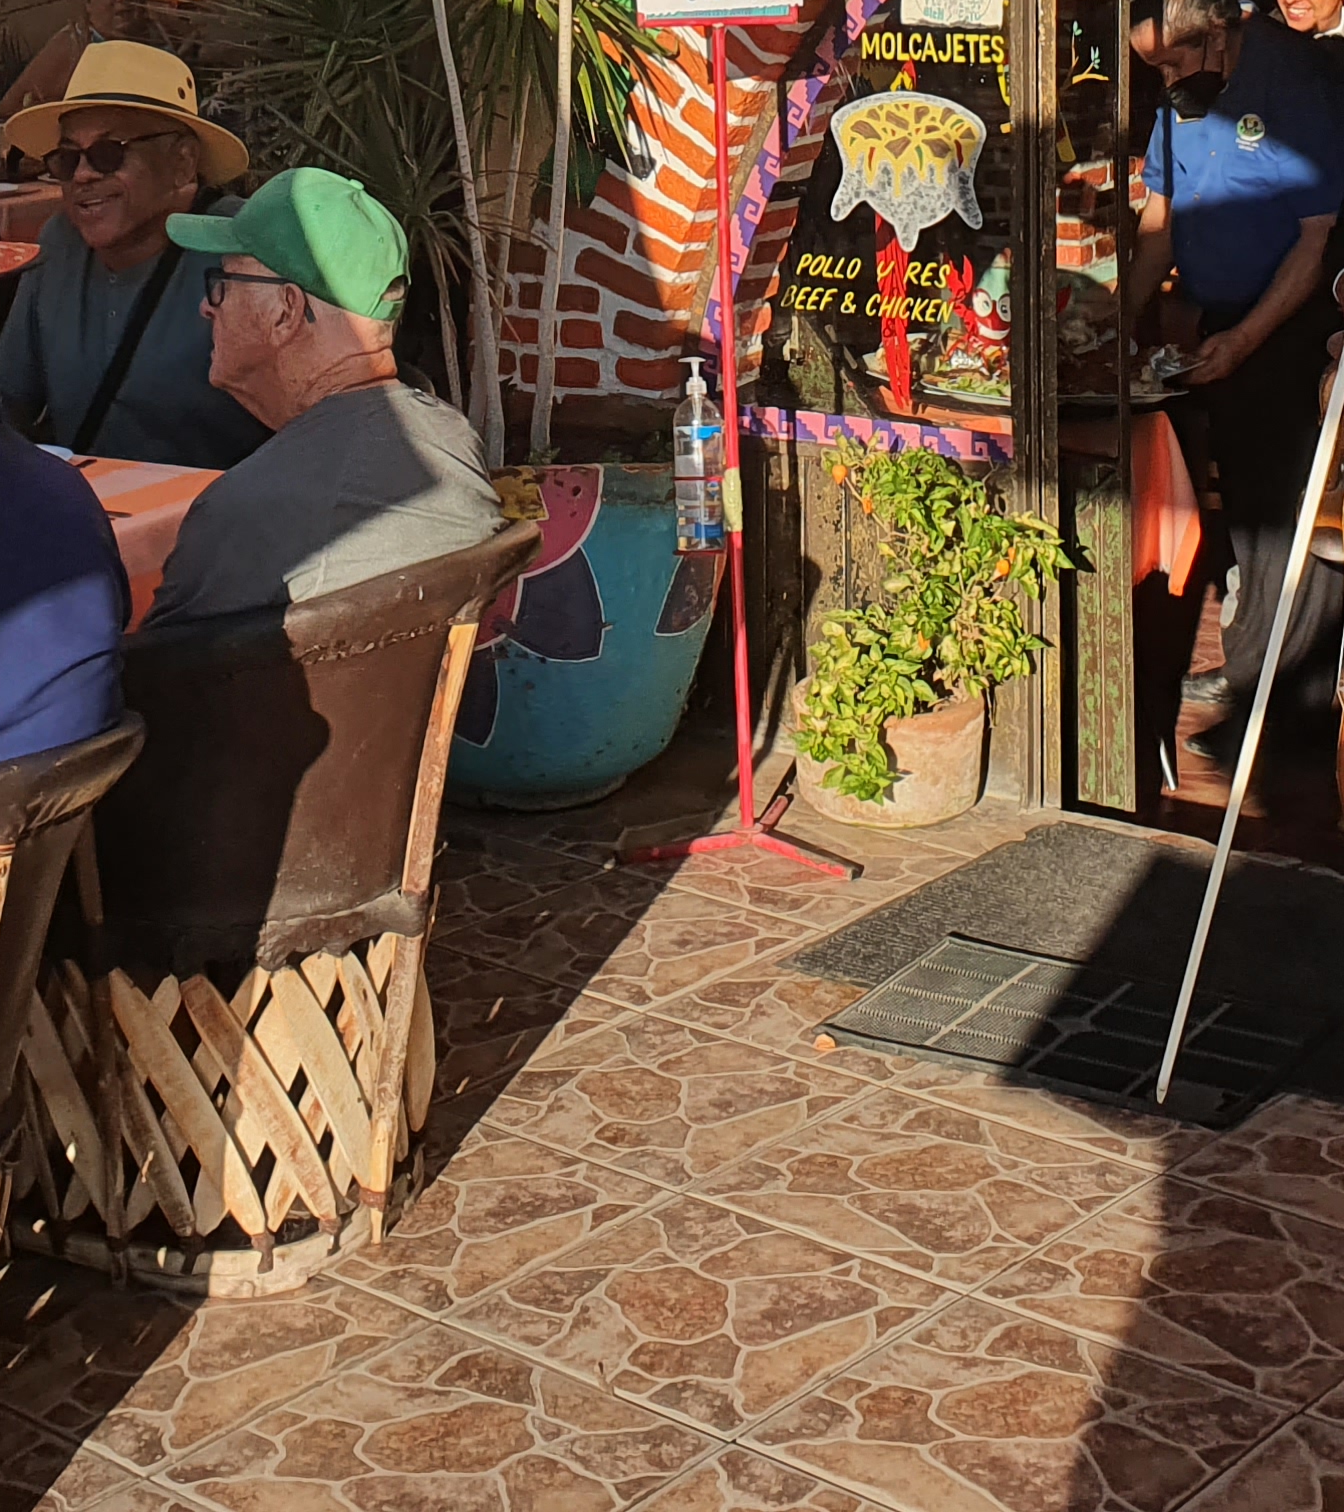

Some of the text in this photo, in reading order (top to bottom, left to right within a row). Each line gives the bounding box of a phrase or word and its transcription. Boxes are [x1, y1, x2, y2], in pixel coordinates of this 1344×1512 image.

[861, 31, 1005, 64] MOLCAJETES
[796, 253, 952, 288] POLLO Y RES
[780, 284, 955, 324] BEEF & CHICKEN
